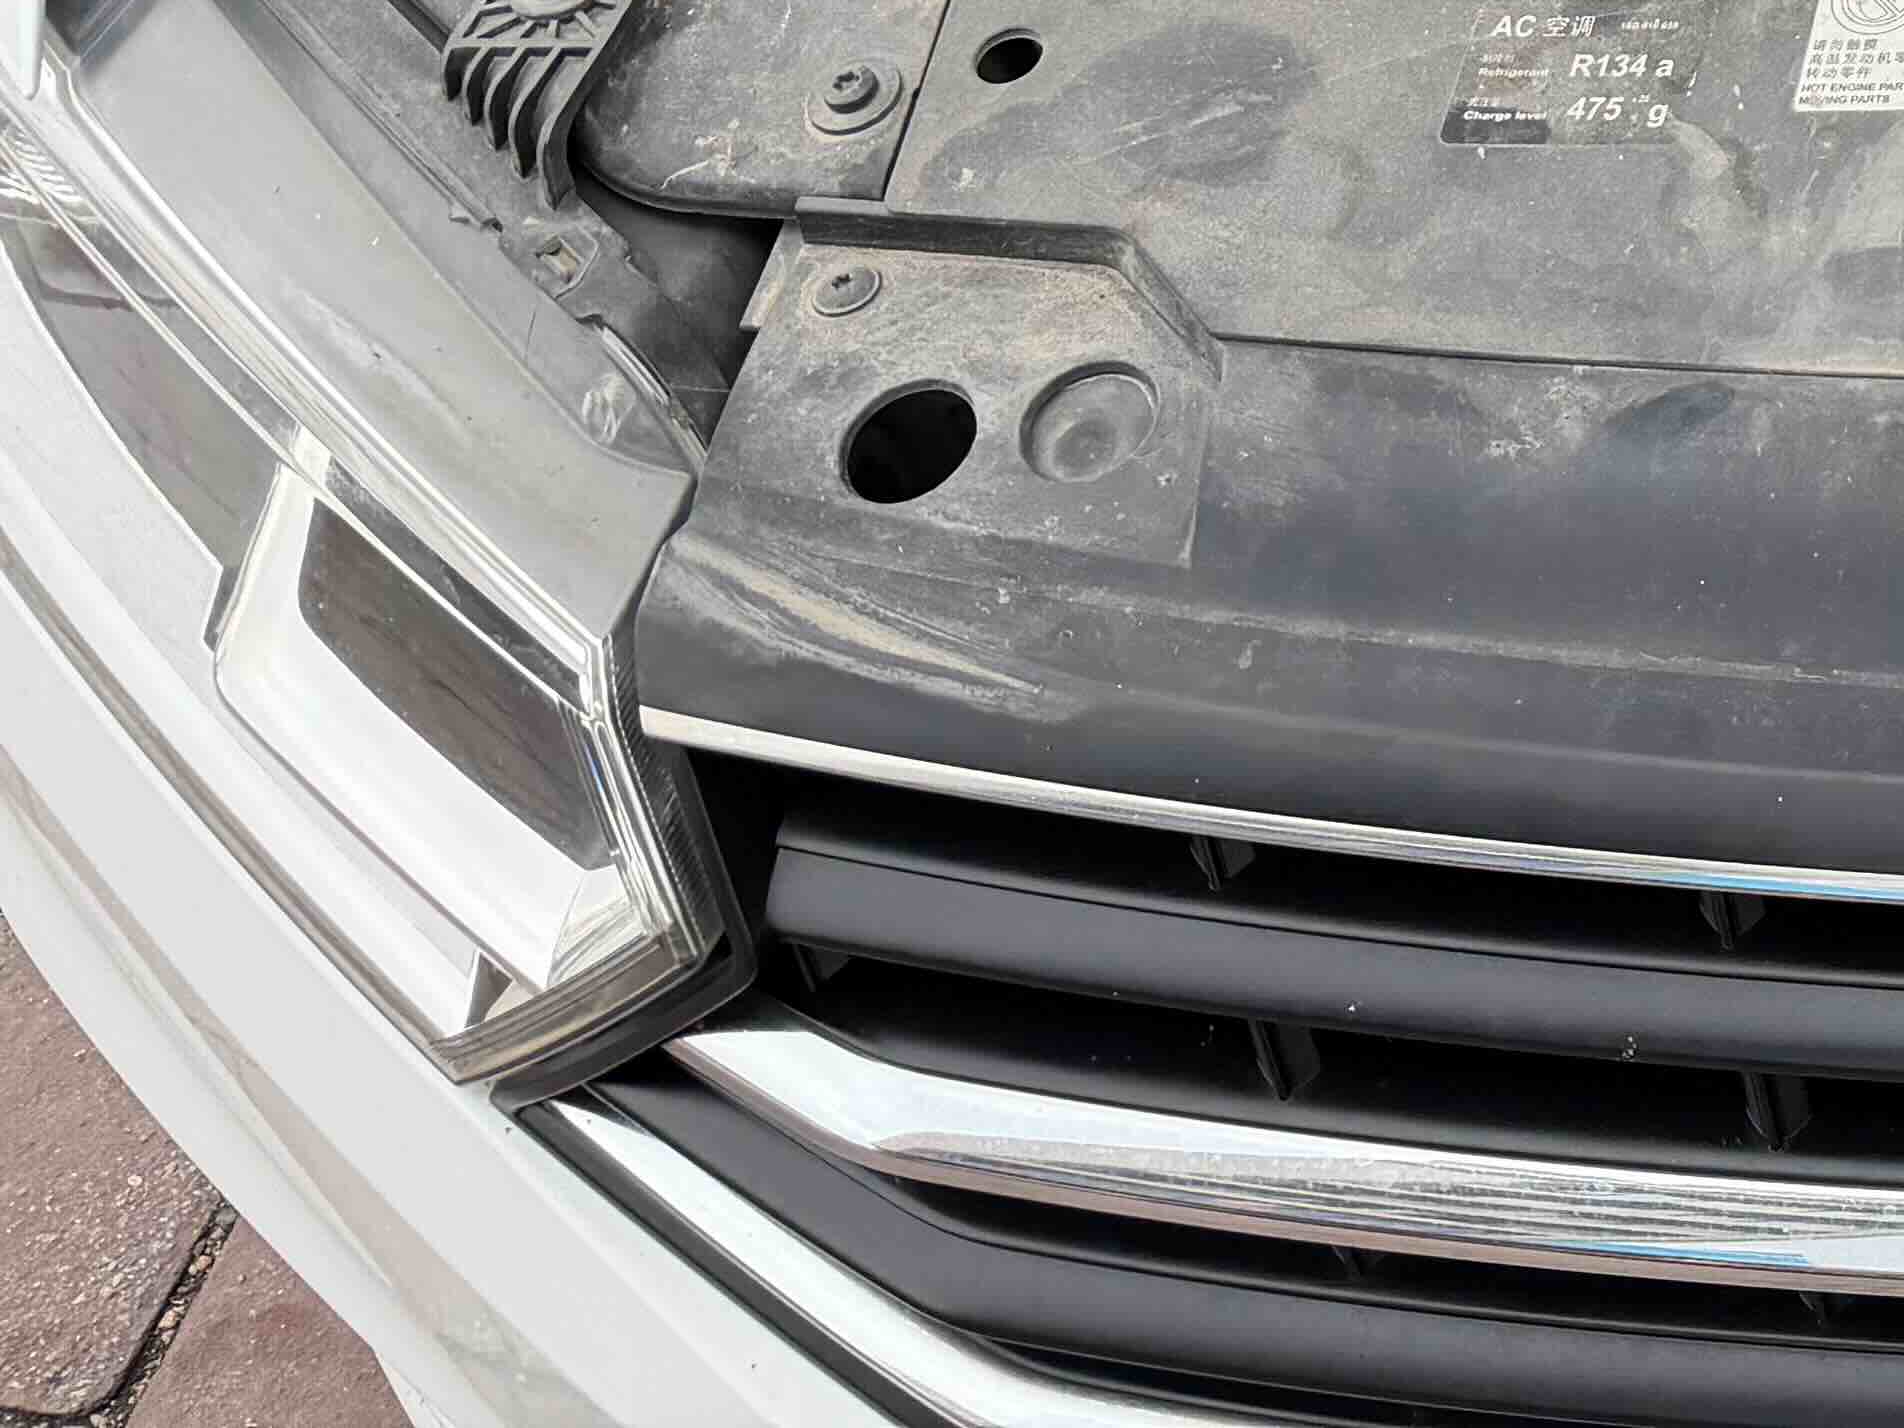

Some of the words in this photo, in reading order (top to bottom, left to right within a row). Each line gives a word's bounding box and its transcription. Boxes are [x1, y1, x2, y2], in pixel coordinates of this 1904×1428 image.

[1491, 15, 1537, 38] AC
[1543, 15, 1597, 38] 空调
[1568, 53, 1649, 78] R134
[1655, 58, 1676, 79] a
[1801, 82, 1826, 92] HOT
[1830, 82, 1877, 92] ENGINE
[1850, 94, 1891, 104] PARTS
[1463, 110, 1513, 122] Charge
[1515, 110, 1548, 121] level
[1565, 96, 1625, 121] 475
[1647, 103, 1670, 128] g
